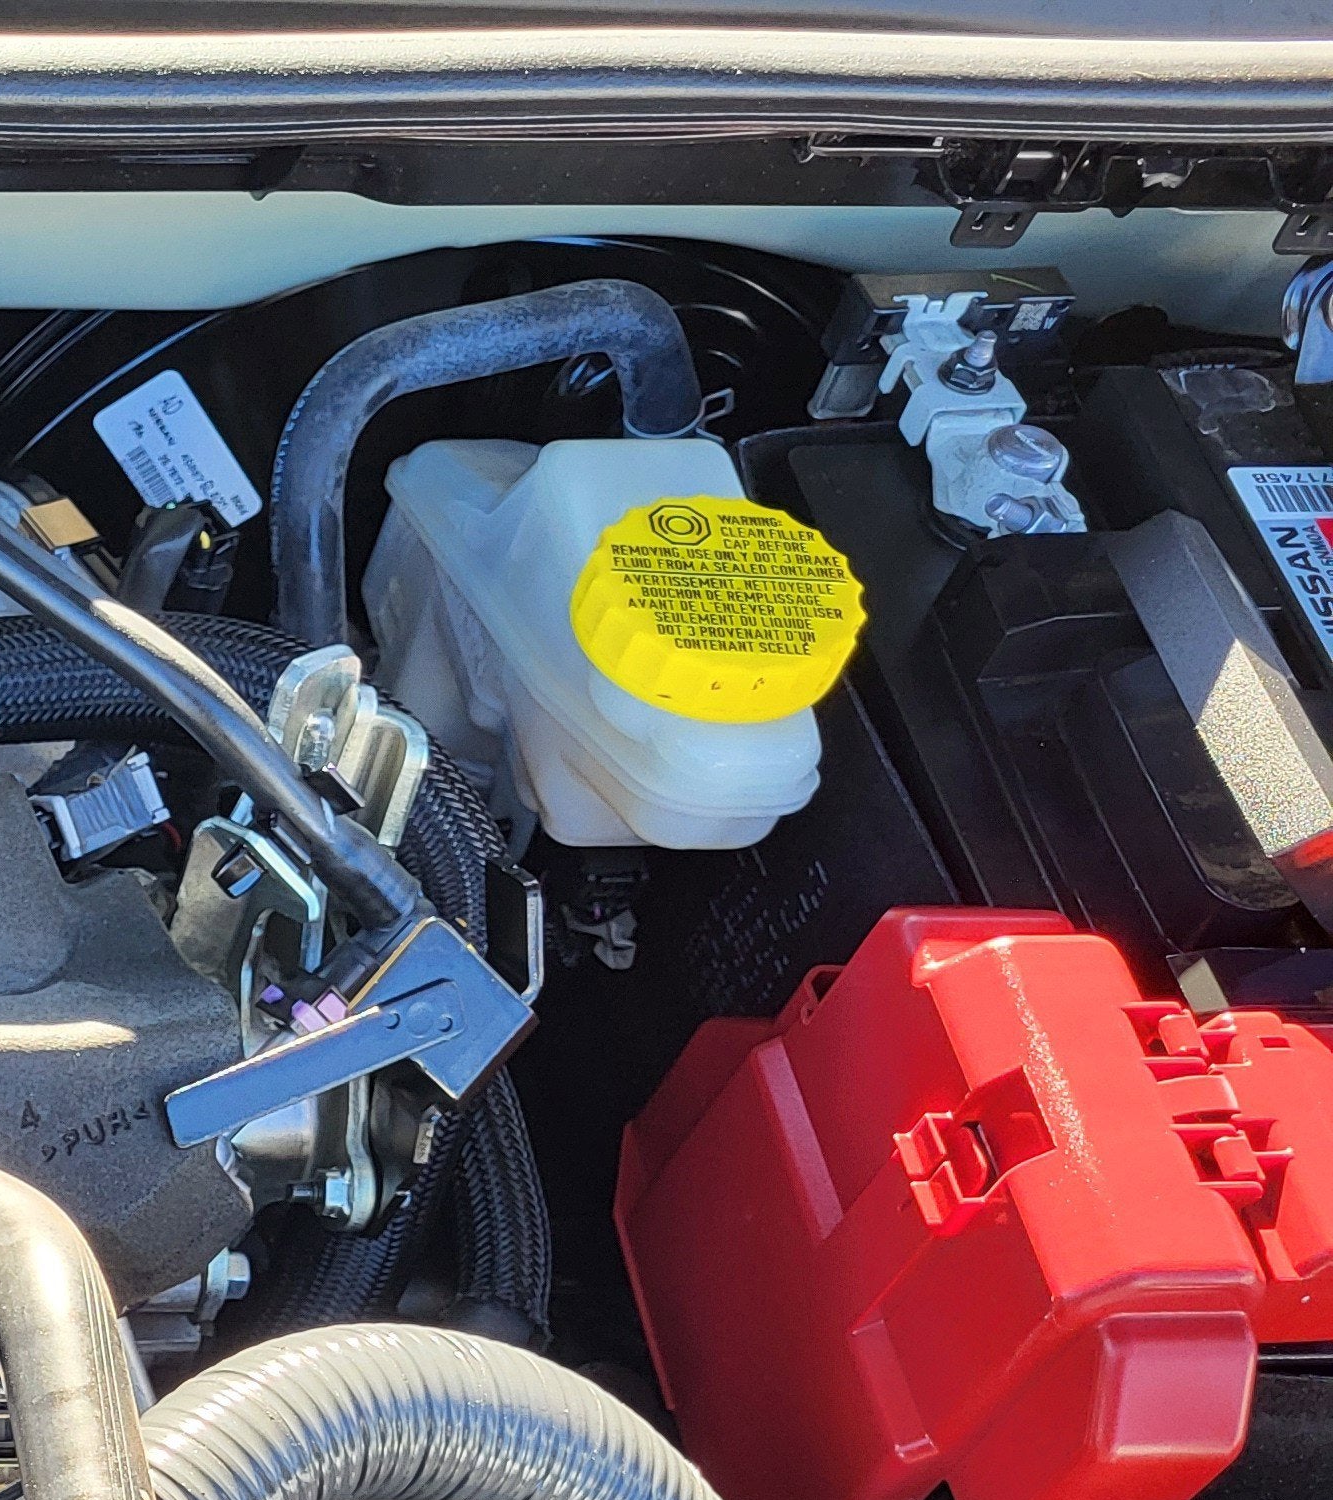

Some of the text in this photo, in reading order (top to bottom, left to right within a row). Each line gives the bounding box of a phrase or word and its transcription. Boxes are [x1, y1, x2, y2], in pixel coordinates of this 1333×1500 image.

[717, 514, 783, 527] WARNING:
[720, 527, 815, 541] CLEAN FILLER
[723, 538, 808, 553] CAP BEFORE
[613, 557, 652, 569] FLUID
[657, 559, 695, 571] FROM
[699, 561, 709, 571] A
[713, 562, 767, 575] SEALED
[687, 548, 712, 560] USE
[714, 551, 748, 562] ONLY
[753, 552, 778, 563] DOT
[782, 553, 790, 563] 3
[795, 554, 842, 567] BRAKE
[641, 587, 823, 606] BOUCHON DE REMPLISSAGE
[744, 580, 813, 593] NETTOYER
[817, 583, 835, 595] LE
[628, 598, 675, 610] AVANT
[680, 600, 698, 612] DE
[783, 605, 844, 620] UTILISER
[654, 612, 814, 630] SEULEMENT DU LIQUIDE
[656, 624, 816, 643] DOT 3 PROVENANT D'UN
[674, 638, 754, 652] CONTENANT
